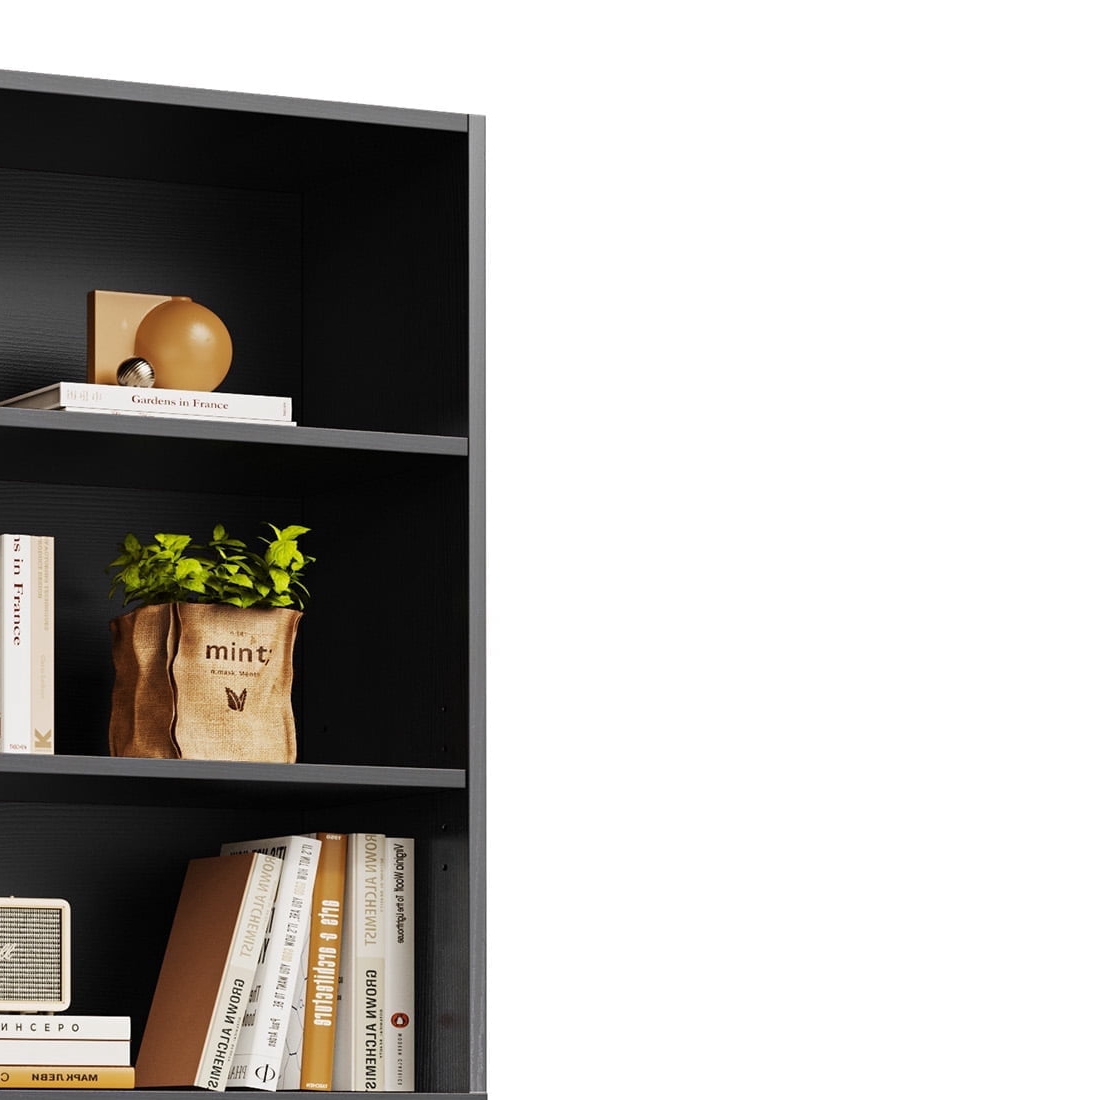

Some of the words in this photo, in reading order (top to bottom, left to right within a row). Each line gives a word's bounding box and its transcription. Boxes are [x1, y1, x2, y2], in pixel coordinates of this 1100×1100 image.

[131, 394, 177, 407] Gardens
[179, 397, 190, 408] in
[193, 398, 229, 410] France
[13, 559, 24, 575] in
[13, 583, 24, 646] France
